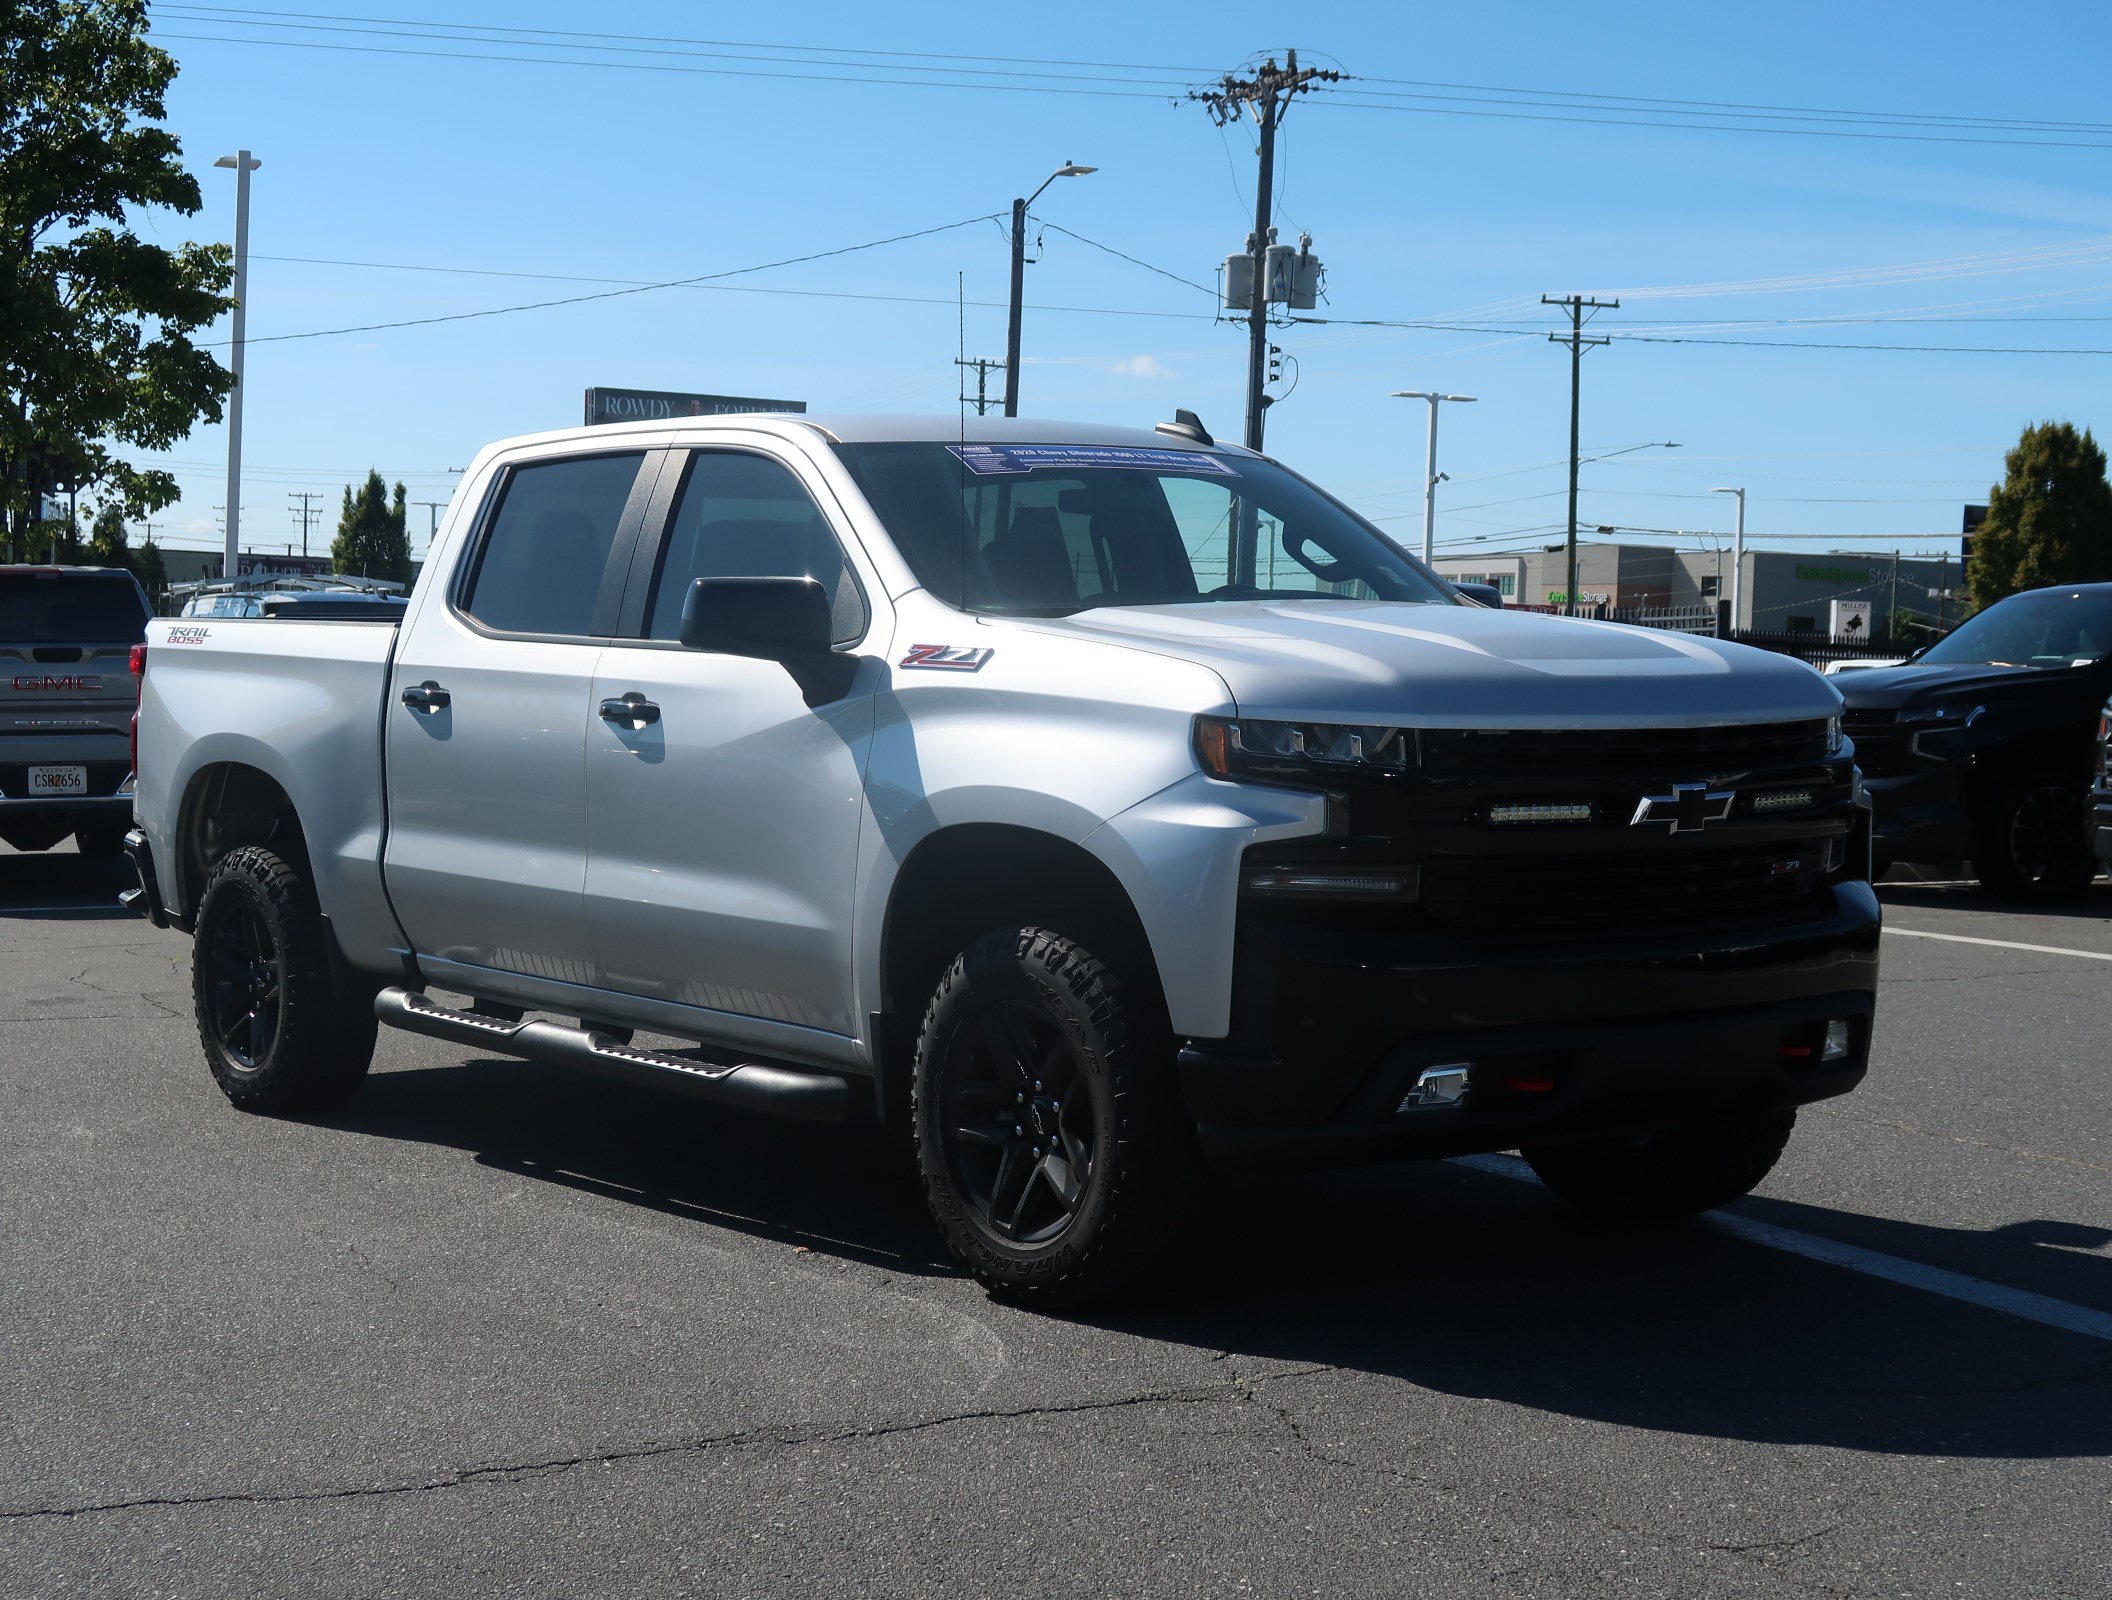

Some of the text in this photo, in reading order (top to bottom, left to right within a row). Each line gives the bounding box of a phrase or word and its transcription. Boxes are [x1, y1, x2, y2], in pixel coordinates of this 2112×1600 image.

[605, 396, 676, 419] ROWDY
[168, 626, 212, 637] TRAIL
[167, 636, 204, 645] BOSS
[898, 643, 994, 673] Z71
[12, 675, 103, 692] GMC
[34, 773, 82, 788] CSB2656
